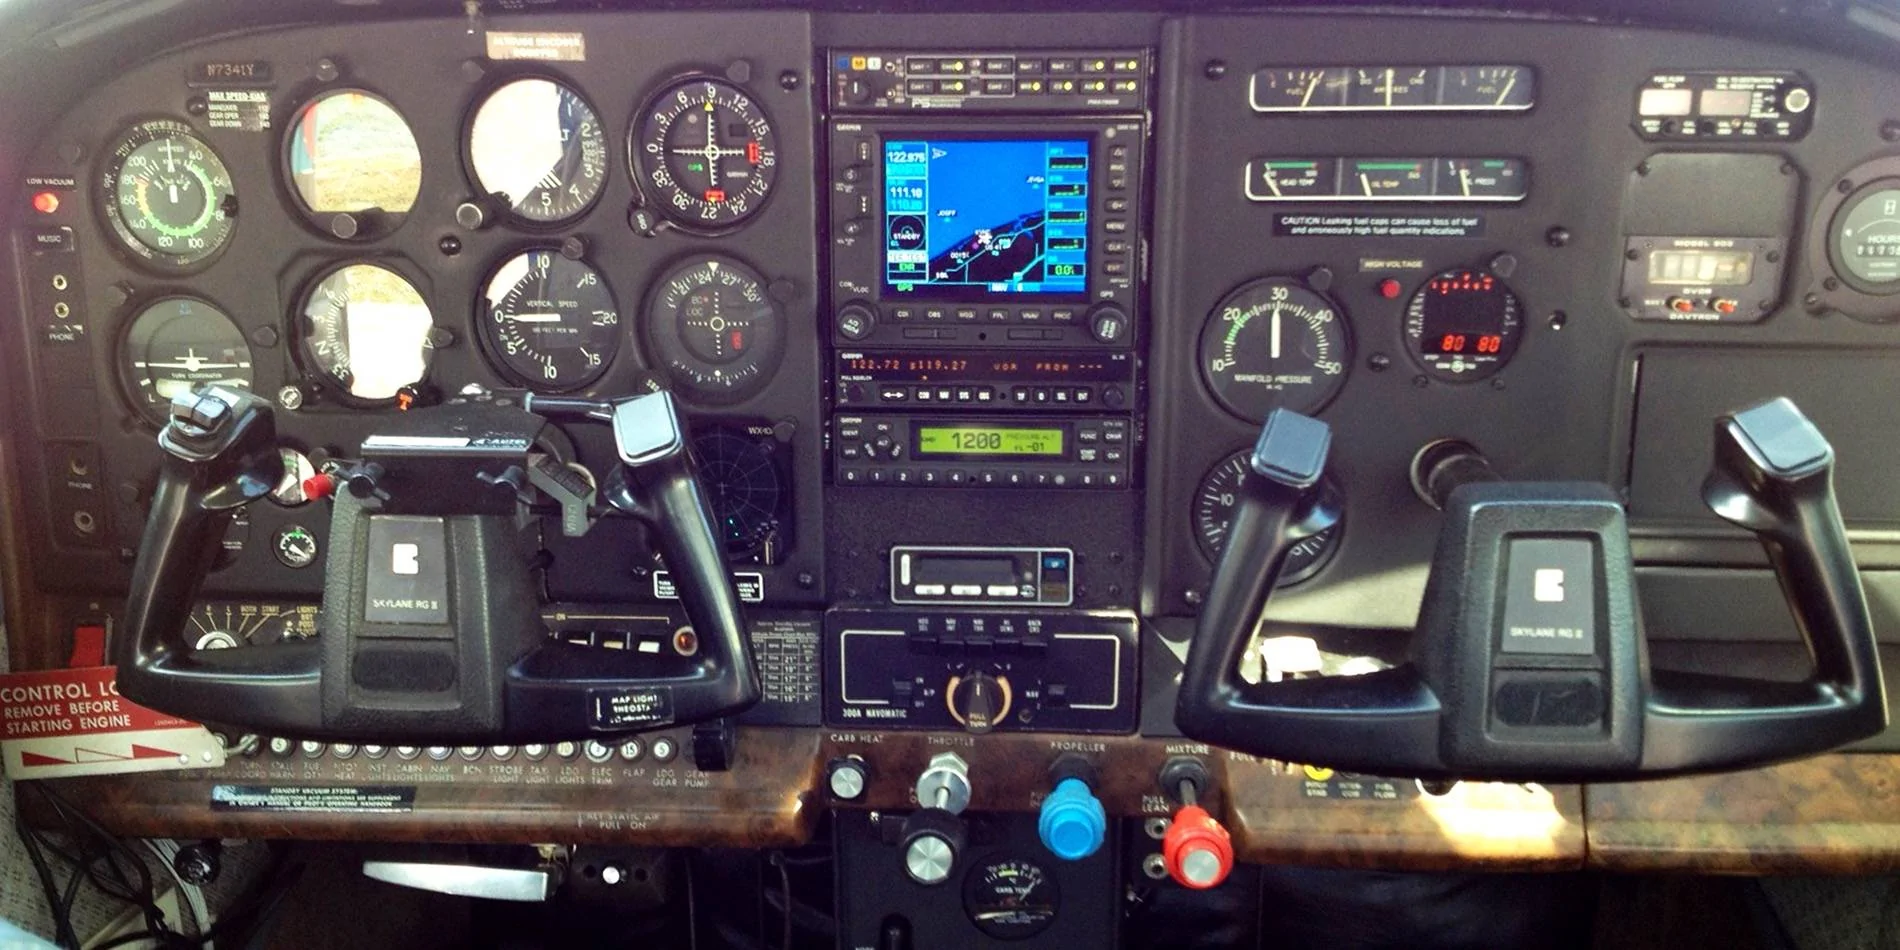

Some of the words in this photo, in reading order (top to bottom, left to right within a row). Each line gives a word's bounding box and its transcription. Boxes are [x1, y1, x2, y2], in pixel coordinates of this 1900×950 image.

[676, 90, 688, 105] 6
[706, 85, 717, 99] 9
[732, 93, 750, 112] 12
[653, 111, 667, 126] 3
[580, 122, 592, 138] 2
[753, 117, 771, 137] 15
[646, 143, 659, 154] 0
[762, 150, 776, 168] 18
[583, 163, 595, 178] 3
[651, 169, 669, 189] 33
[753, 179, 769, 197] 21
[541, 192, 553, 207] 5
[671, 192, 691, 211] 30
[700, 207, 718, 220] 27
[730, 201, 748, 217] 24
[536, 254, 551, 270] 10
[1386, 260, 1423, 269] VOLTAGE
[584, 272, 598, 286] 15
[699, 271, 712, 285] 24
[721, 275, 738, 287] 27
[1271, 286, 1289, 301] 30
[493, 309, 505, 324] 0
[602, 312, 618, 325] 20
[1222, 307, 1242, 321] 20
[1313, 309, 1334, 323] 40
[314, 340, 331, 357] N
[506, 342, 518, 356] 5
[1441, 335, 1466, 352] 80
[1477, 335, 1501, 353] 80
[588, 353, 602, 367] 15
[1212, 358, 1226, 372] 10
[543, 365, 558, 380] 10
[1323, 361, 1342, 375] 50
[1234, 373, 1273, 384] MANIFOLD
[1274, 375, 1313, 384] PRESSURE
[952, 432, 1001, 449] 1200
[1220, 493, 1235, 507] 10
[373, 599, 414, 609] SKYLANE
[415, 600, 430, 610] RG
[1510, 627, 1556, 638] SKYLANE
[1557, 628, 1573, 638] RG
[0, 682, 91, 704] CONTROL
[4, 703, 62, 720] REMOVE
[69, 700, 120, 715] BEFORE
[6, 718, 73, 735] STARTING
[80, 714, 132, 730] ENGINE
[830, 733, 856, 743] CARB
[927, 736, 976, 747] THROTTLE
[1050, 741, 1106, 752] PROPELLER
[1165, 744, 1210, 755] MIXTURE
[488, 765, 523, 775] STROBE
[590, 767, 613, 777] ELEC
[1141, 804, 1170, 813] LEAN
[629, 821, 647, 830] ON
